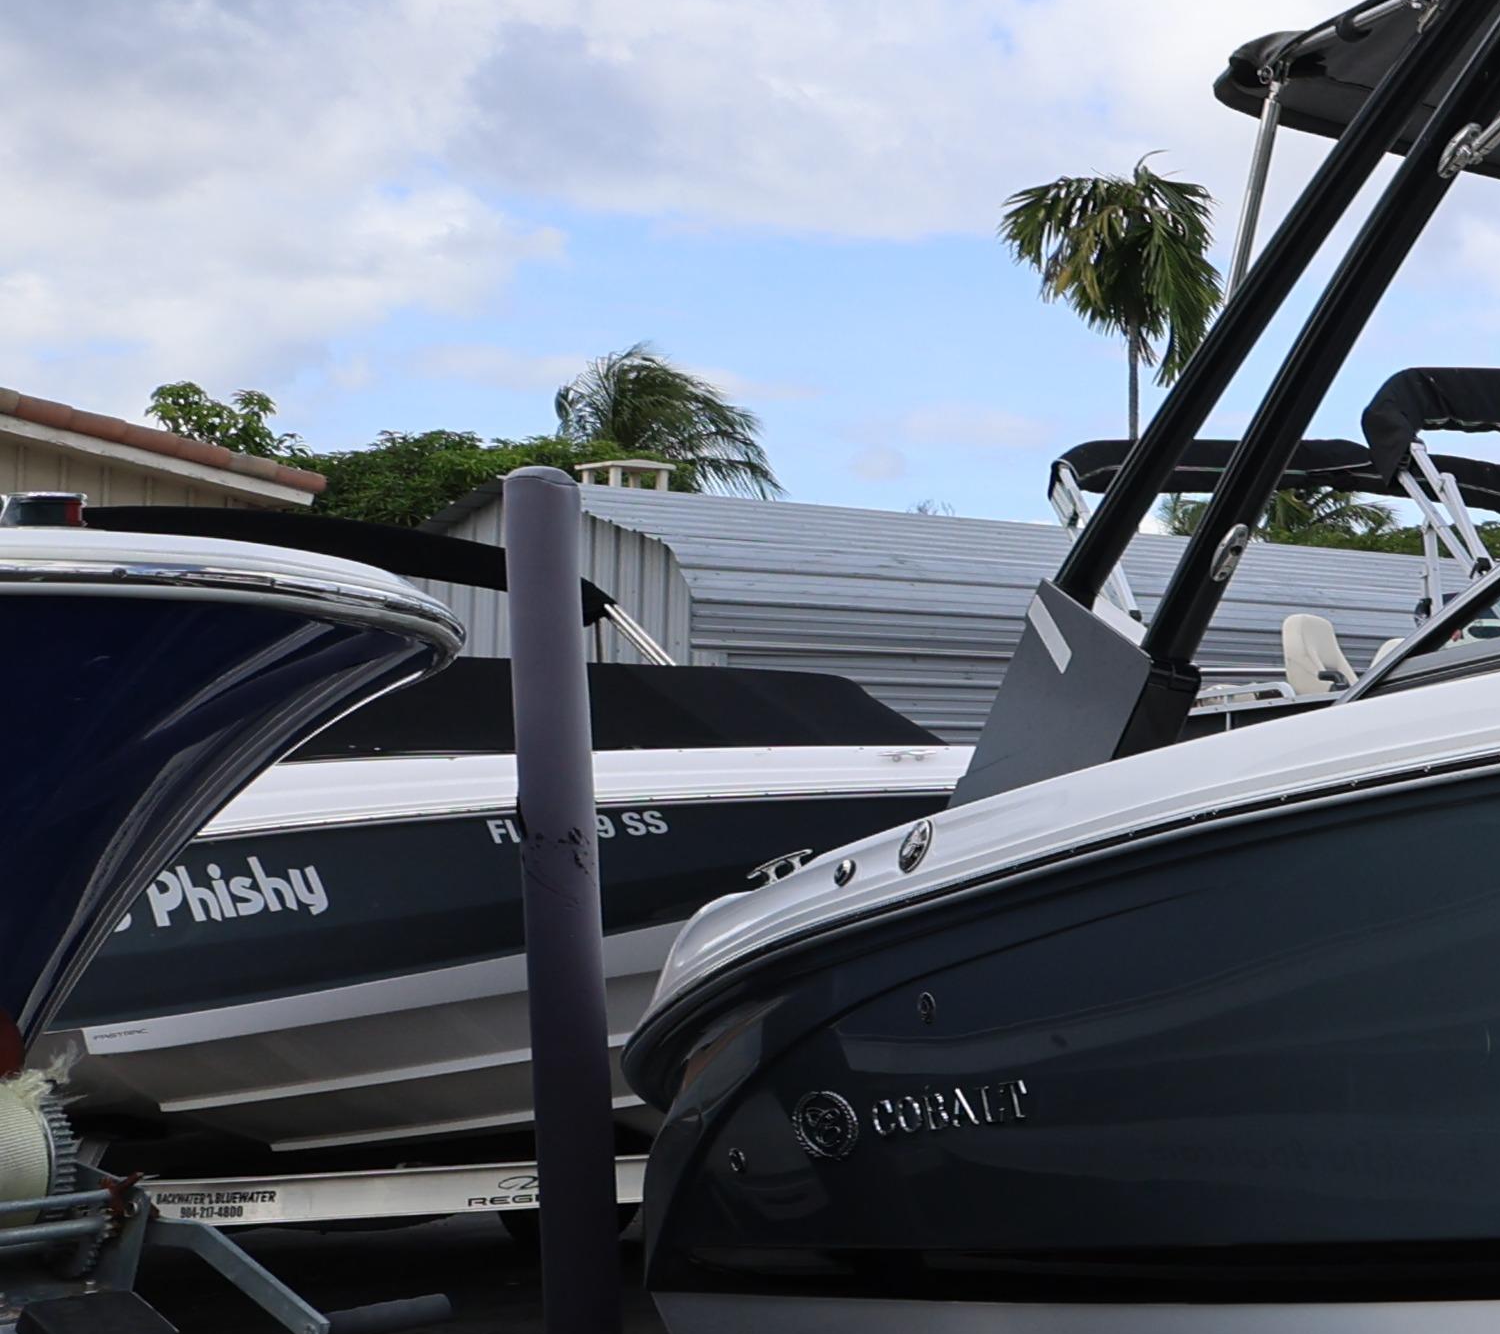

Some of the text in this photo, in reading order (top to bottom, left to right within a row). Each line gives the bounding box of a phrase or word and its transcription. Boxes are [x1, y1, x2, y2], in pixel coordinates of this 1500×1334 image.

[622, 810, 669, 836] SS
[147, 856, 329, 927] Phishy
[871, 1079, 1028, 1135] COBALT
[468, 1194, 540, 1207] REG
